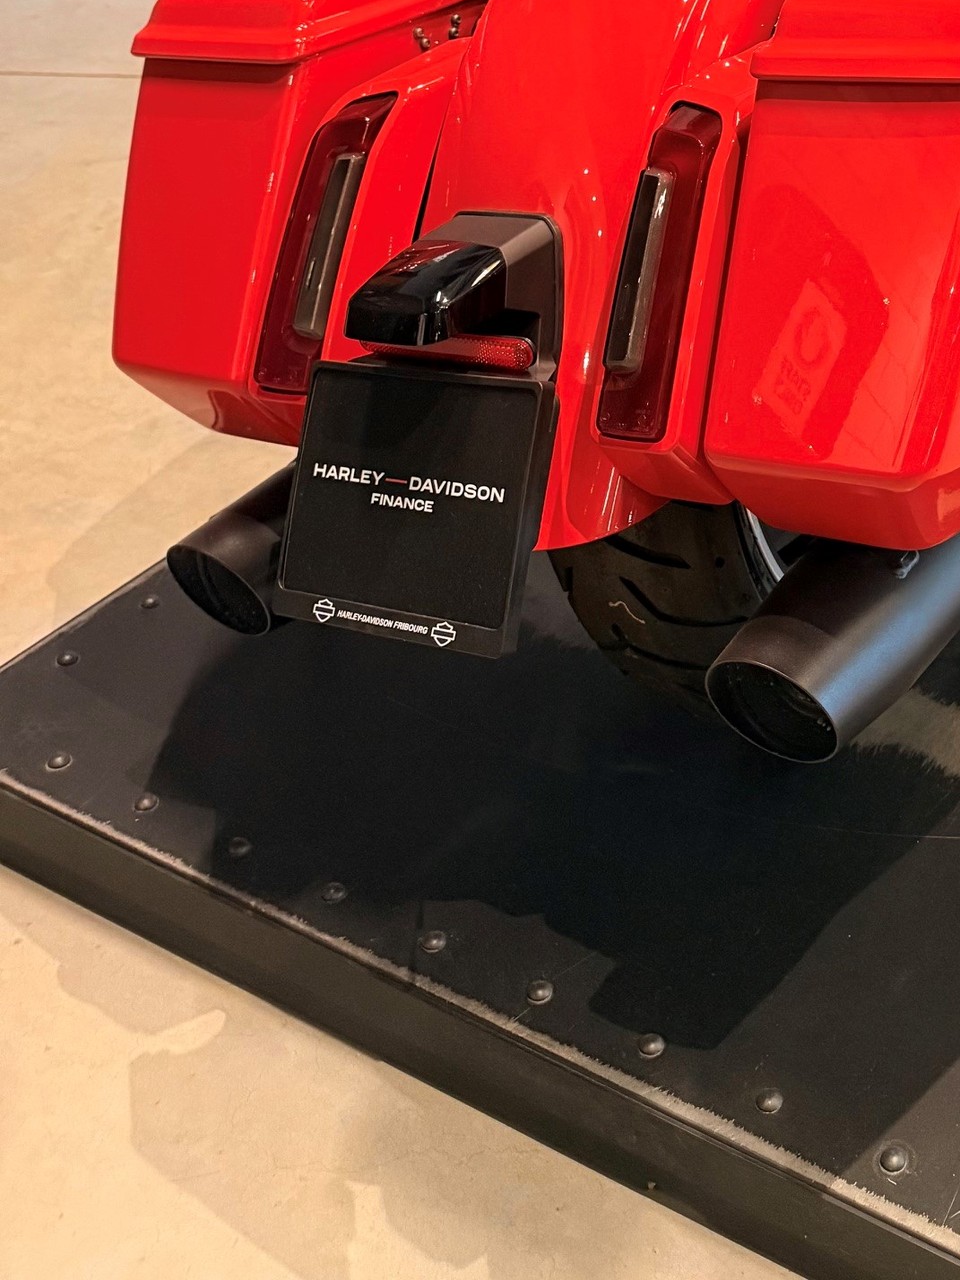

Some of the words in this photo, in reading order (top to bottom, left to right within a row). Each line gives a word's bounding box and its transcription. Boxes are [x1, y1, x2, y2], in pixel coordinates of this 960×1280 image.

[371, 492, 434, 513] FINANCE
[337, 609, 394, 628] HARLEY-DAVIDSON
[393, 621, 428, 635] FRIBOURG
